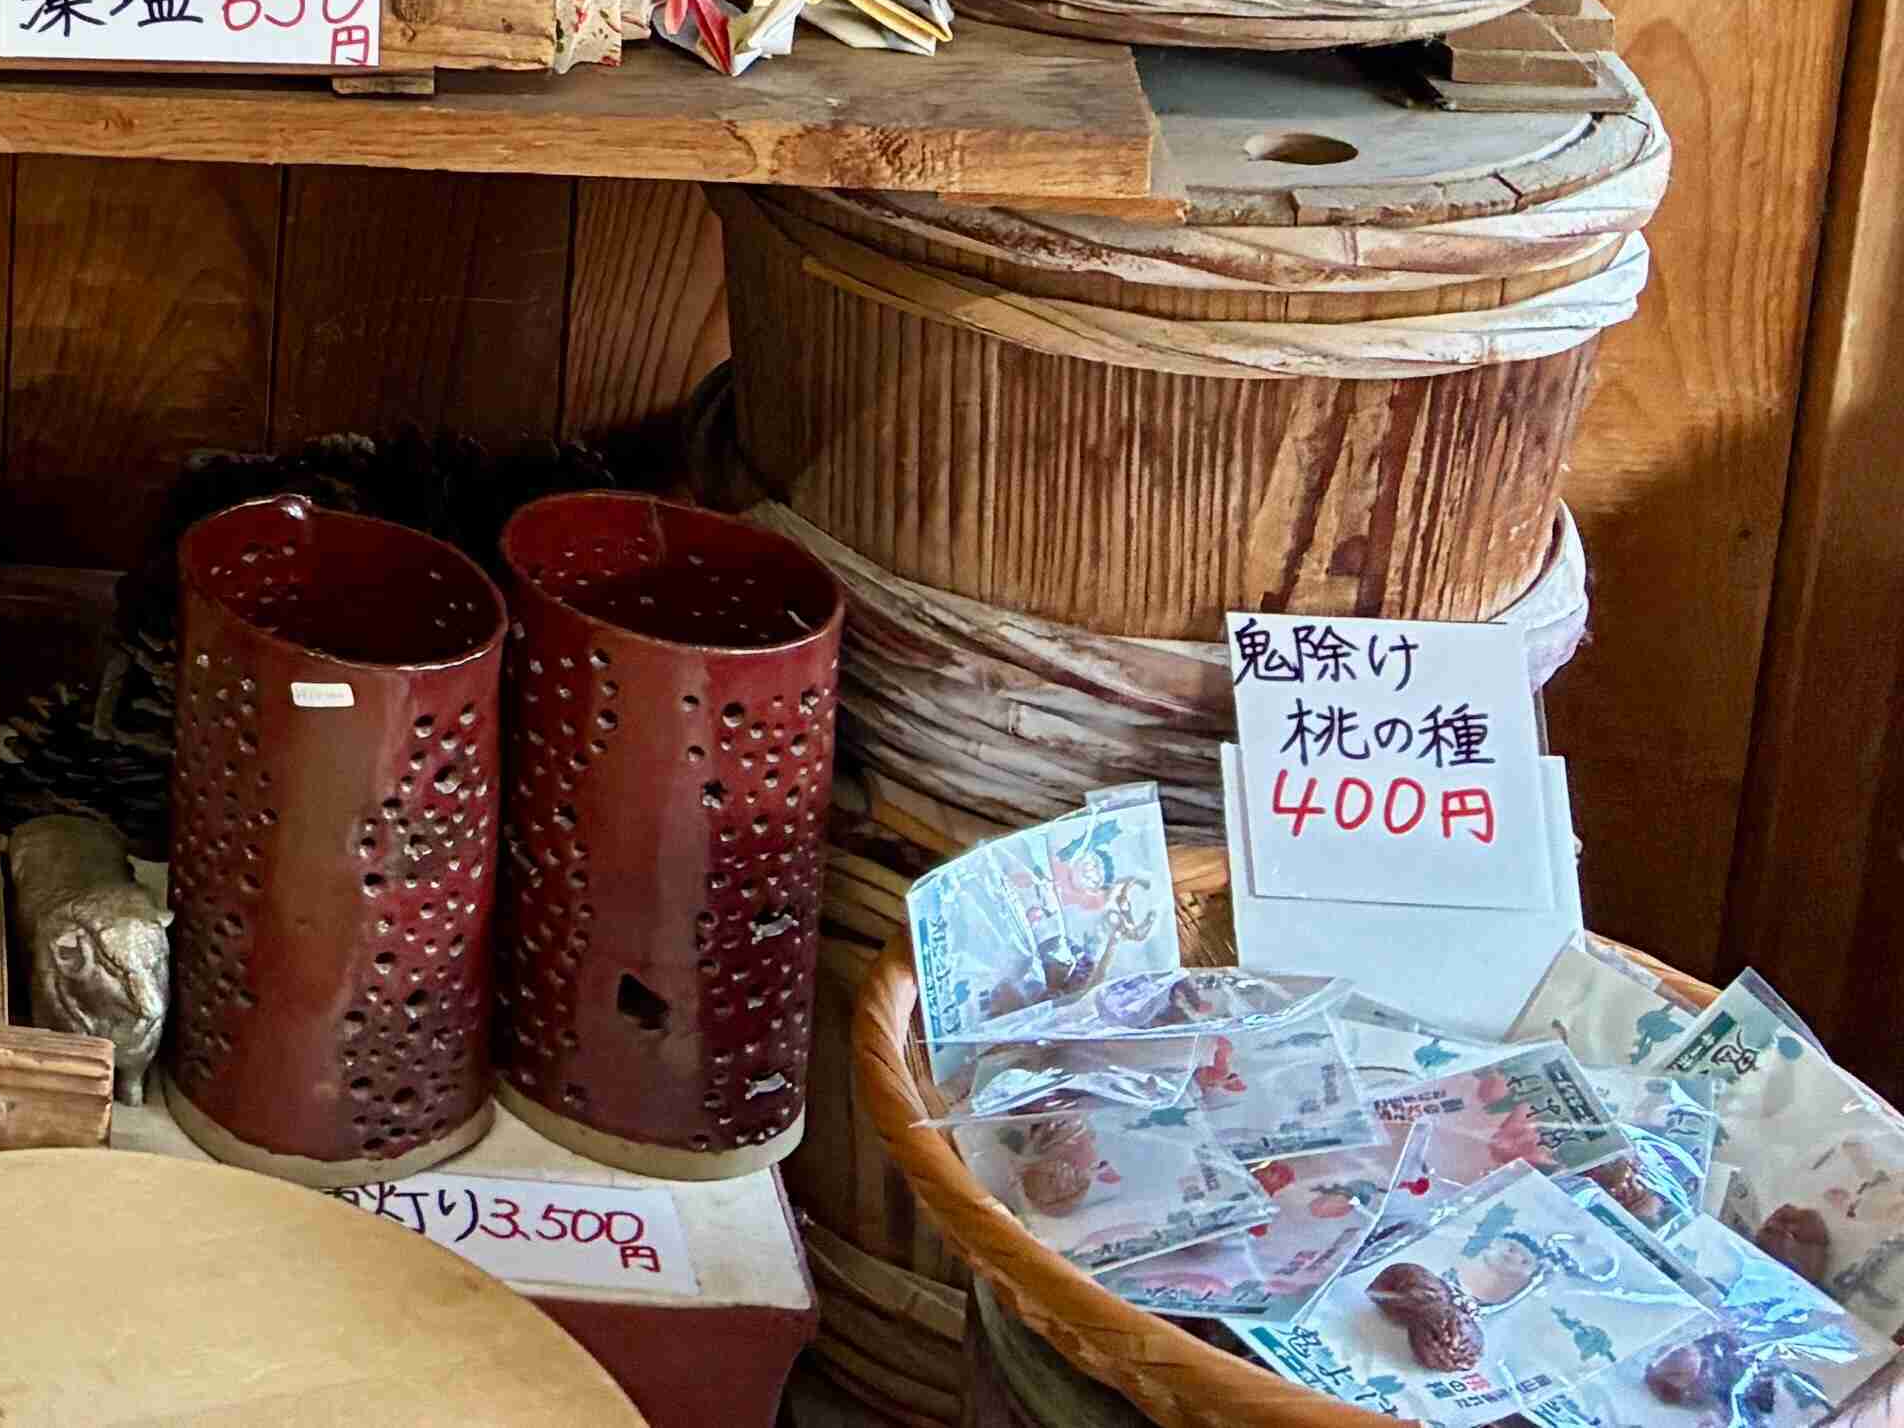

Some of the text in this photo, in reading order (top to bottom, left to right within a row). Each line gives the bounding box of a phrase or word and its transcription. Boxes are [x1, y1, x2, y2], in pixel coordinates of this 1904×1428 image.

[1233, 616, 1420, 691] 鬼除け
[1280, 698, 1497, 769] 桃の種
[1271, 767, 1497, 845] 400円
